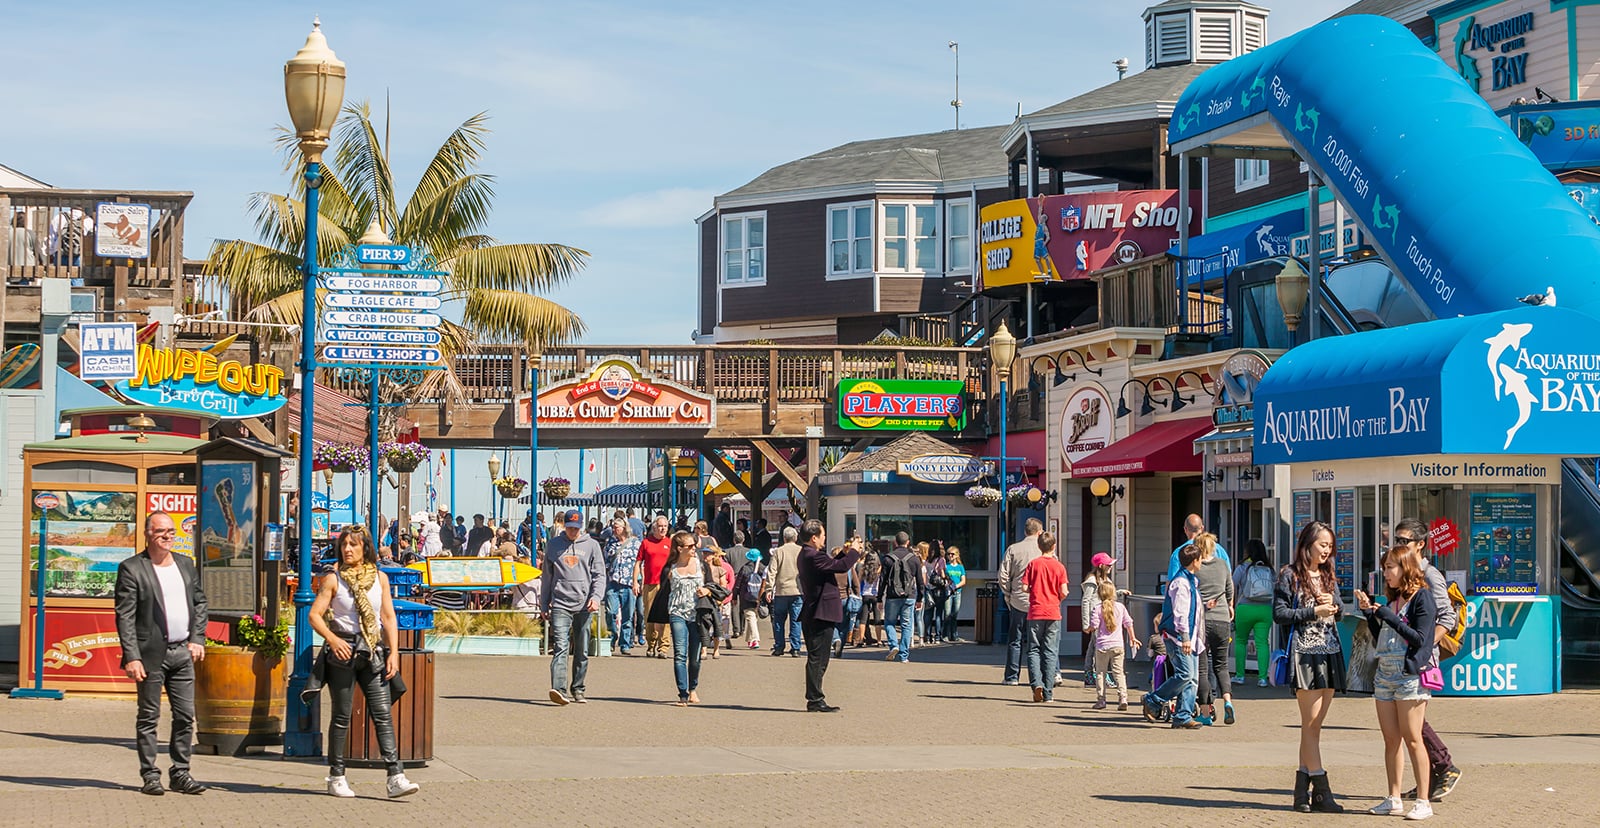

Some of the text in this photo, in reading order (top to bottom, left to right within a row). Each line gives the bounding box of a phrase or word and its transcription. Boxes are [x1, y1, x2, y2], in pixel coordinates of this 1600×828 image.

[1470, 12, 1534, 52] AQUARIUM
[1492, 53, 1529, 91] BAY
[1269, 75, 1291, 107] Rays
[1564, 127, 1585, 141] 3D
[1323, 135, 1369, 199] 20,000 Fish
[1084, 203, 1127, 230] NFL
[981, 215, 1023, 245] COLLEGE
[362, 248, 406, 261] PIER 39
[986, 247, 1012, 271] SHOP
[1405, 235, 1456, 304] Touch Pool
[348, 279, 418, 289] FOG HARBOR
[351, 296, 415, 307] EAGLE CAFE
[348, 313, 417, 324] CRAB HOUSE
[83, 327, 134, 351] ATM
[337, 331, 427, 342] WELCOME CENTER
[86, 357, 131, 365] CASH
[341, 348, 423, 360] LEVEL 2 SHOPS
[129, 343, 285, 397] WIPEOUT
[1566, 371, 1600, 381] OF THE
[575, 384, 598, 396] End of
[635, 383, 659, 397] the Pier
[1540, 377, 1600, 413] BAY
[200, 390, 239, 415] Grill
[578, 400, 618, 418] GUMP
[622, 400, 675, 418] SHRIMP
[679, 400, 705, 418] CO.
[847, 394, 961, 414] PLAYERS
[1216, 407, 1240, 424] Whale
[1262, 386, 1430, 456] AQUARIUM OF THE BAY
[1066, 443, 1085, 453] COFFEE
[904, 463, 989, 474] MONEY EXCHANGE
[1312, 469, 1335, 482] Tickets
[1411, 462, 1547, 478] Visitor Information
[329, 501, 350, 510] Rides
[908, 503, 926, 511] MONEY
[1429, 522, 1450, 538] $12.95
[1466, 601, 1506, 628] BAY
[68, 640, 82, 649] The
[82, 637, 97, 646] San
[1471, 633, 1499, 660] UP
[52, 650, 79, 665] PIER 39
[1451, 663, 1518, 691] CLOSE
